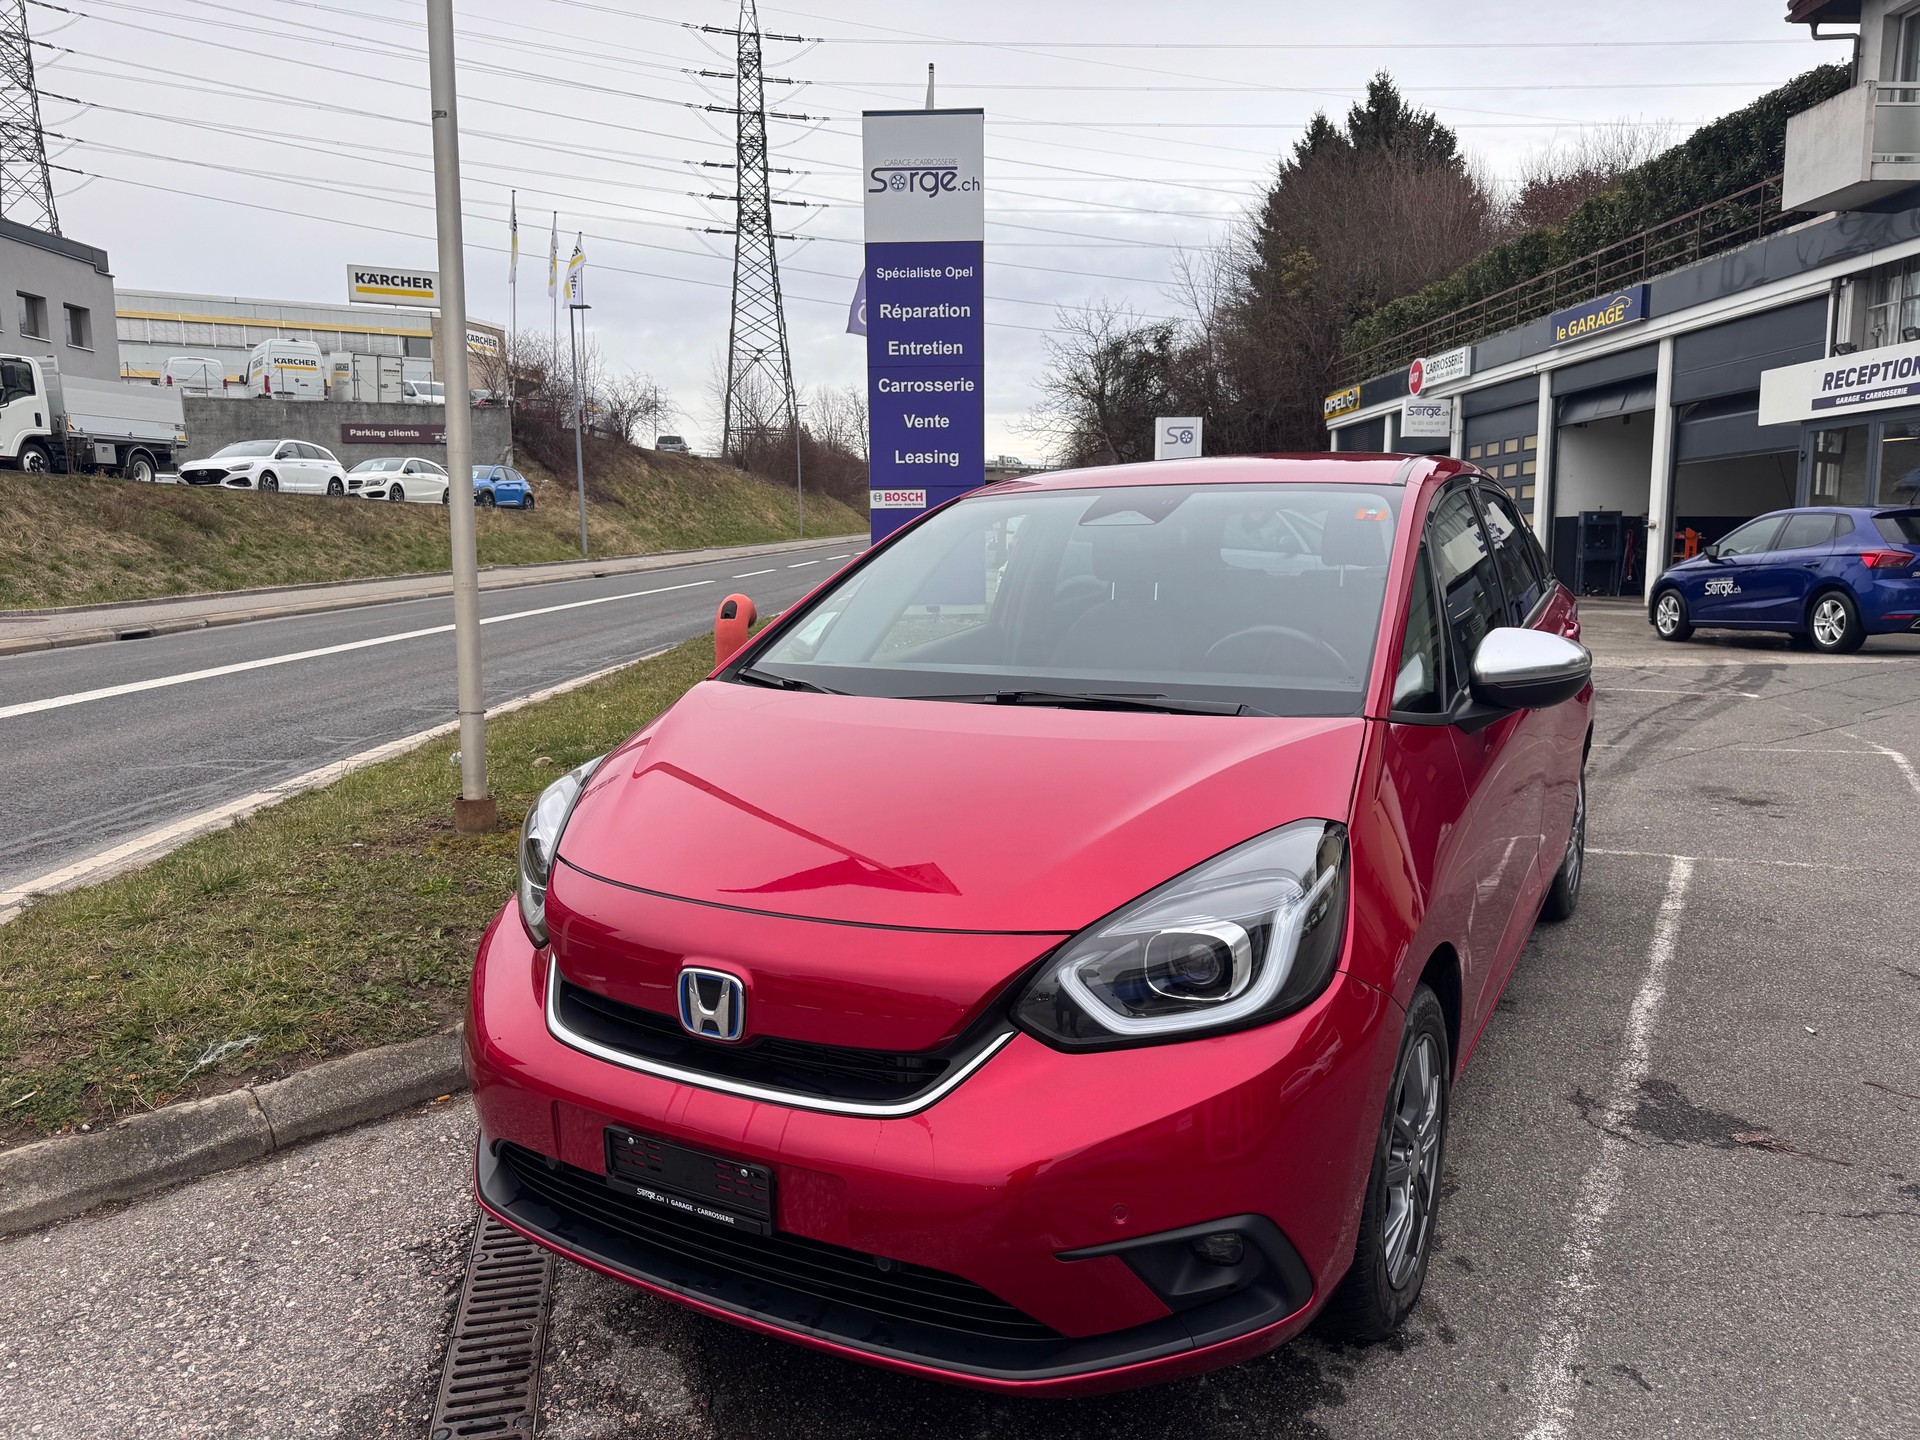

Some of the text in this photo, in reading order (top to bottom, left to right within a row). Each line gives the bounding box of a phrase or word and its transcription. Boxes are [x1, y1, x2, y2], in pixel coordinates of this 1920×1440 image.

[354, 272, 433, 290] KÄRCHER
[876, 266, 973, 281] Spécialiste Opel
[879, 303, 971, 322] Réparation
[1556, 304, 1625, 341] le GARAGE
[888, 340, 963, 356] Entretien
[273, 357, 317, 367] KÄRCHER
[1425, 352, 1464, 375] CARROSSERIE
[1822, 355, 1920, 392] RECEPTION
[878, 377, 975, 393] Carrosserie
[1324, 395, 1346, 414] OPEL
[1835, 387, 1908, 405] GARAGE CARROSSERIE
[903, 414, 950, 429] Vente
[349, 428, 420, 438] Parking clients
[895, 449, 959, 467] Leasing
[884, 492, 923, 502] BOSCH
[670, 1199, 693, 1212] GARAGE
[697, 1207, 735, 1225] CARROSSERIE
